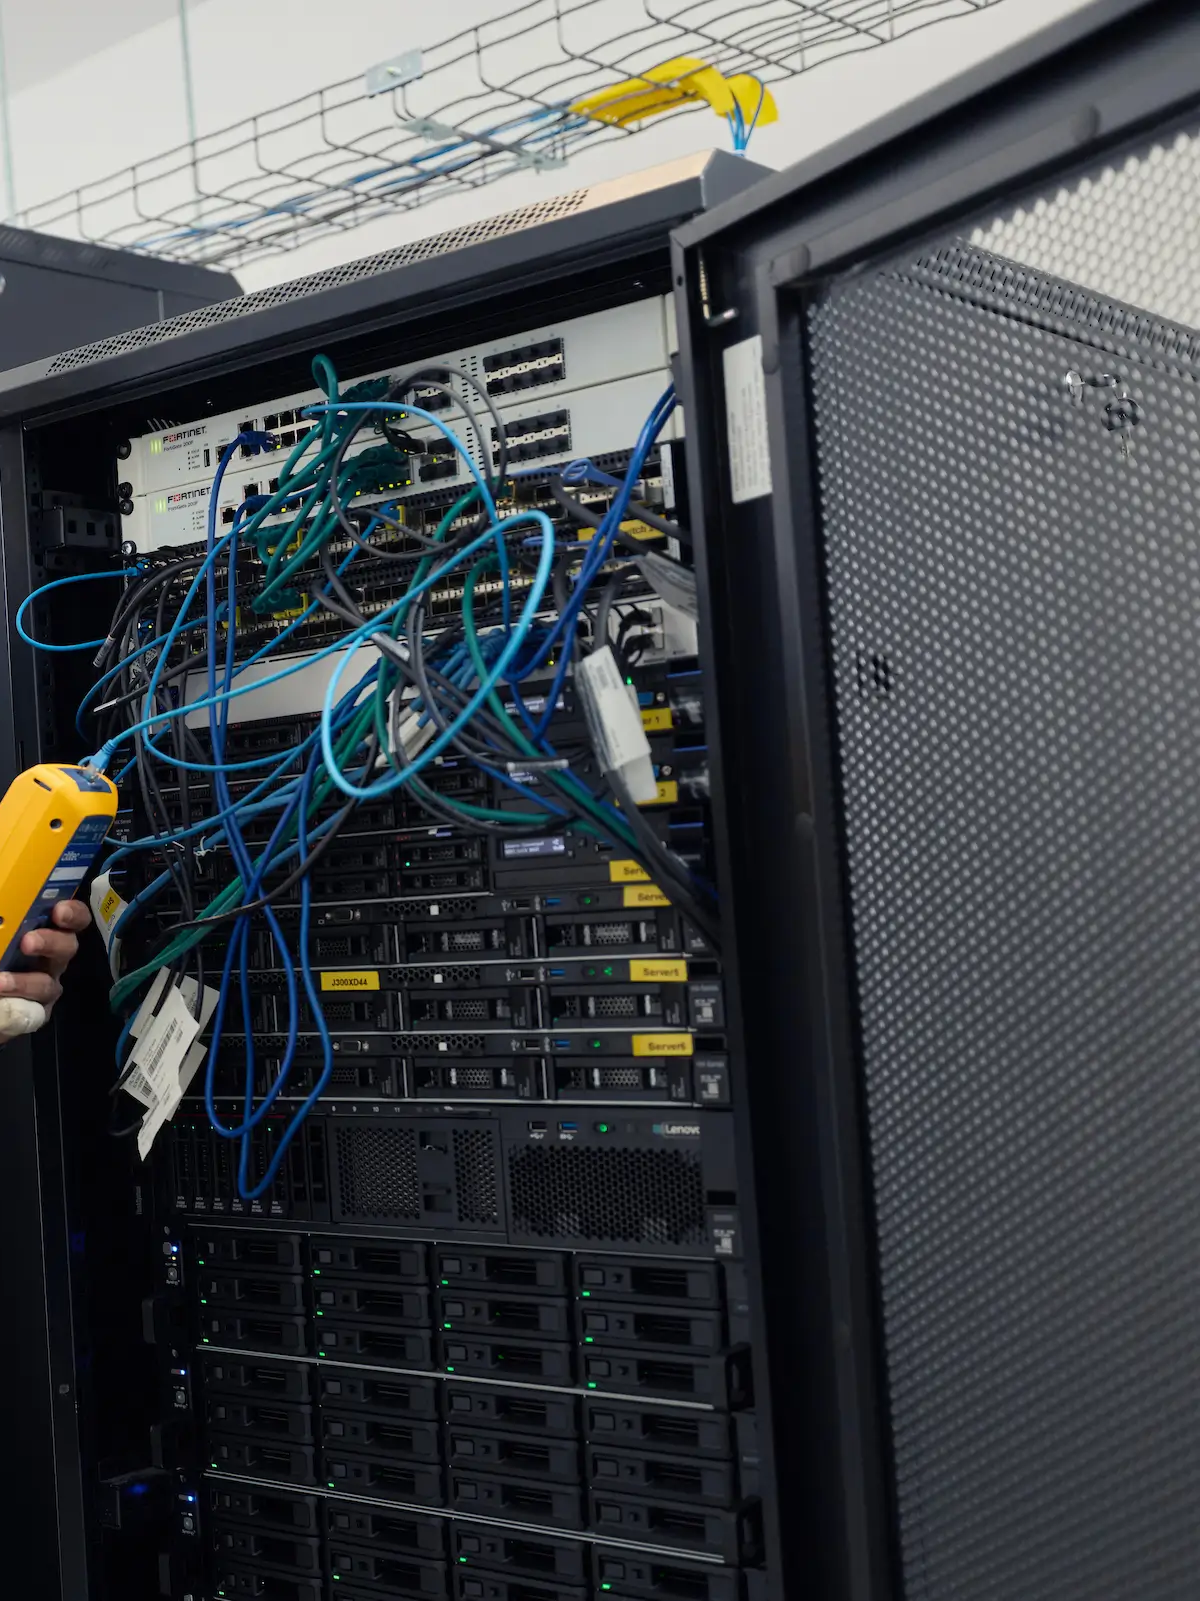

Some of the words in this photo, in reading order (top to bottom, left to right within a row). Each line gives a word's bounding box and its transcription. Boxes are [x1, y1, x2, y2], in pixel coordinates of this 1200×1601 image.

[163, 426, 207, 444] FORTINET
[164, 443, 182, 452] FortiGate
[168, 486, 211, 503] FORTINET
